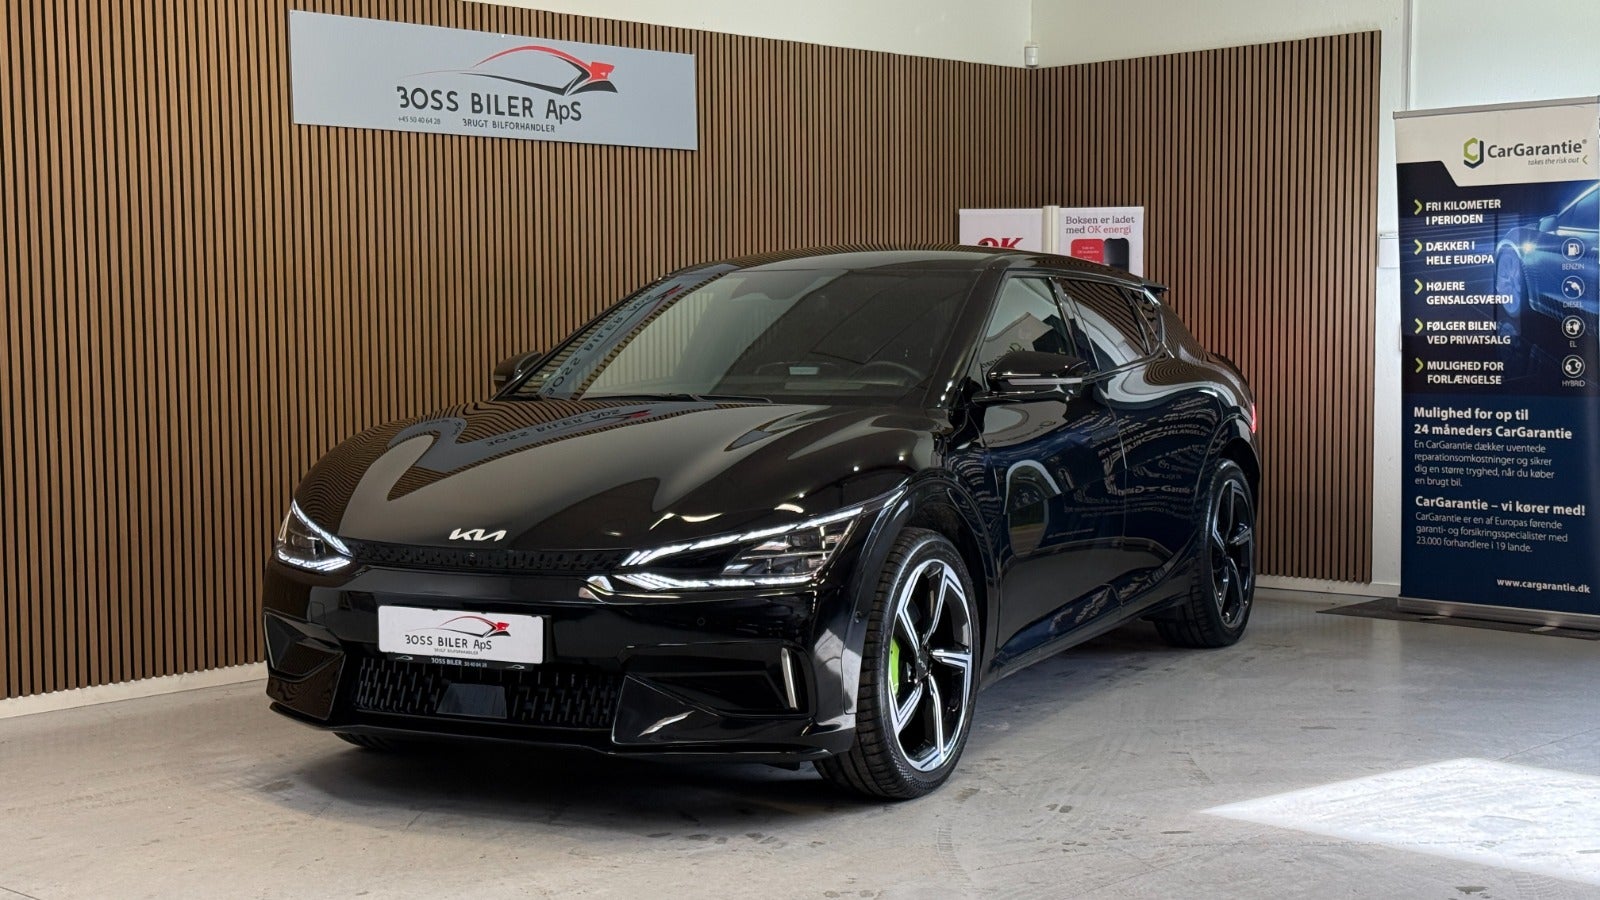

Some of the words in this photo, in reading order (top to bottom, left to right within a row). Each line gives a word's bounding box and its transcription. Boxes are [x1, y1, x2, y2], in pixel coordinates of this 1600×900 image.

[471, 92, 534, 118] BILER
[546, 98, 582, 125] ApS
[492, 120, 556, 133] BILFORHANDLER
[1426, 202, 1442, 212] FRI
[1444, 200, 1502, 212] KILOMETER
[1066, 216, 1098, 224] Boksen
[1112, 215, 1136, 224] ladet
[1432, 214, 1484, 226] PERIODEN
[1066, 225, 1086, 234] med
[1087, 225, 1102, 234] OK
[1103, 225, 1132, 236] energi
[1426, 241, 1470, 252] DÆKKER
[1426, 256, 1452, 266] HELE
[1454, 254, 1495, 265] EUROPA
[1426, 281, 1465, 292] HØJERE
[1426, 294, 1514, 306] GENSALGSVÆRDI
[1426, 320, 1465, 332] FØLGER
[1467, 320, 1497, 331] BILEN
[1427, 335, 1448, 345] VED
[1450, 335, 1512, 346] PRIVATSALG
[1427, 361, 1481, 372] MULIGHED
[1483, 360, 1504, 371] FOR
[1427, 374, 1502, 386] FORLÆNGELSE
[1562, 380, 1586, 388] HYBRID
[1414, 406, 1472, 421] Mulighed
[1474, 408, 1492, 420] for
[1496, 410, 1512, 422] op
[1515, 408, 1529, 420] til
[1414, 424, 1428, 434] 24
[1432, 424, 1492, 437] måneders
[1496, 426, 1572, 440] CarGarantie
[1414, 440, 1424, 449] En
[1426, 440, 1472, 451] CarGarantie
[1474, 441, 1504, 452] dækker
[1506, 444, 1546, 453] uventede
[1414, 453, 1515, 466] reparationsomkostninger
[1516, 458, 1528, 467] og
[1530, 456, 1552, 466] sikrer
[1414, 465, 1428, 475] dig
[1441, 466, 1464, 475] større
[1466, 467, 1500, 478] tryghed,
[1502, 468, 1515, 477] når
[1516, 469, 1528, 478] du
[1530, 470, 1554, 479] køber
[1427, 478, 1449, 488] brugt
[1450, 478, 1462, 487] bil.
[1416, 496, 1488, 510] CarGarantie
[1501, 500, 1512, 512] vi
[1516, 501, 1550, 514] kører
[1553, 504, 1586, 516] med!
[1416, 512, 1462, 524] CarGarantie
[1486, 516, 1494, 525] af
[1494, 517, 1528, 529] Europas
[1530, 519, 1562, 530] førende
[449, 528, 507, 542] KIA
[1416, 525, 1446, 536] garanti-
[1448, 528, 1459, 538] og
[1460, 526, 1547, 542] forsikringsspecialister
[1548, 533, 1568, 542] med
[1416, 536, 1442, 546] 23.000
[1444, 538, 1489, 550] forhandlere
[1496, 542, 1506, 550] 19
[1507, 543, 1532, 552] lande.
[1496, 578, 1590, 594] www.cargarantie.dk
[438, 636, 468, 648] BILER
[473, 640, 492, 652] ApS
[446, 658, 462, 666] BILER
